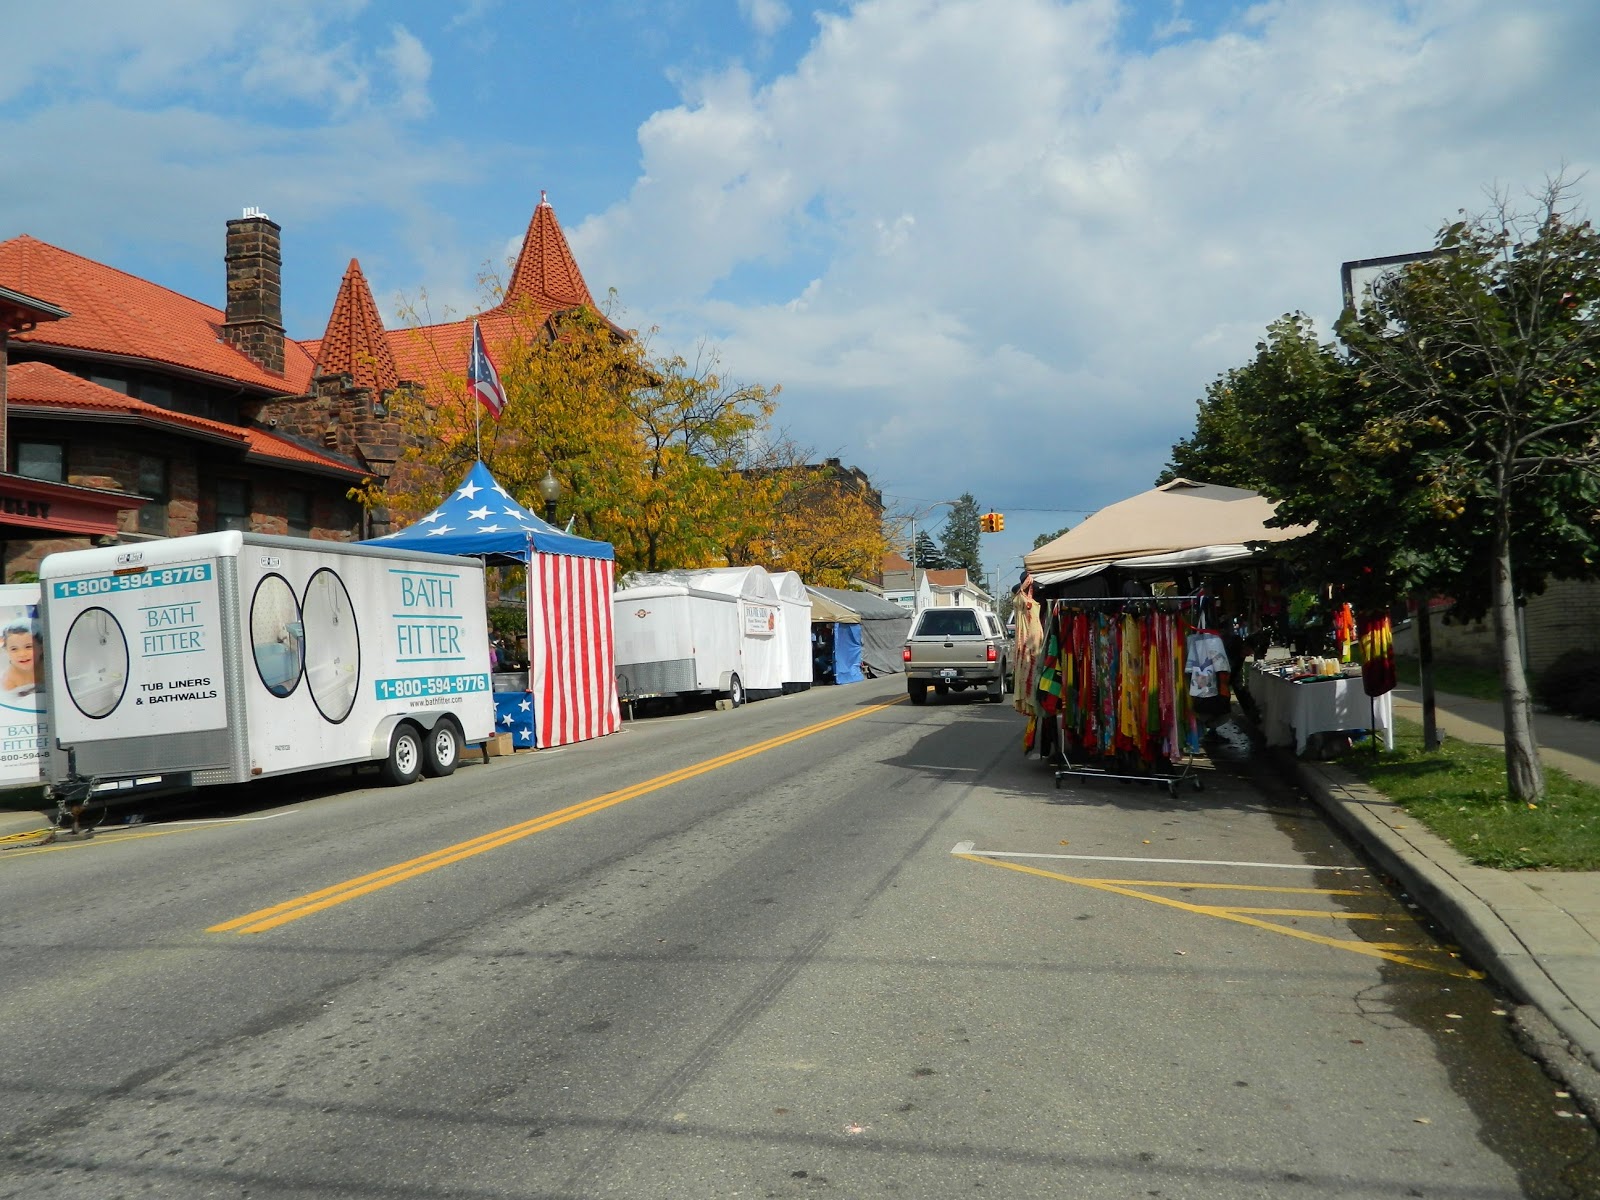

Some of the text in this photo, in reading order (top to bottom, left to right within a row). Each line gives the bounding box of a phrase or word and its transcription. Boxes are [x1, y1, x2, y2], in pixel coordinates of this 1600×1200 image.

[60, 566, 205, 597] 1-800-594-8776
[401, 577, 453, 608] BATH
[147, 606, 194, 627] BATH
[143, 631, 201, 653] FITTER
[397, 624, 461, 655] FITTER
[140, 677, 211, 692] TUB LINERS
[380, 675, 486, 698] 1-800-594-8776
[136, 690, 217, 706] & BATHWALLS
[410, 696, 463, 708] www.bathfitter.com
[8, 723, 49, 737] BATH
